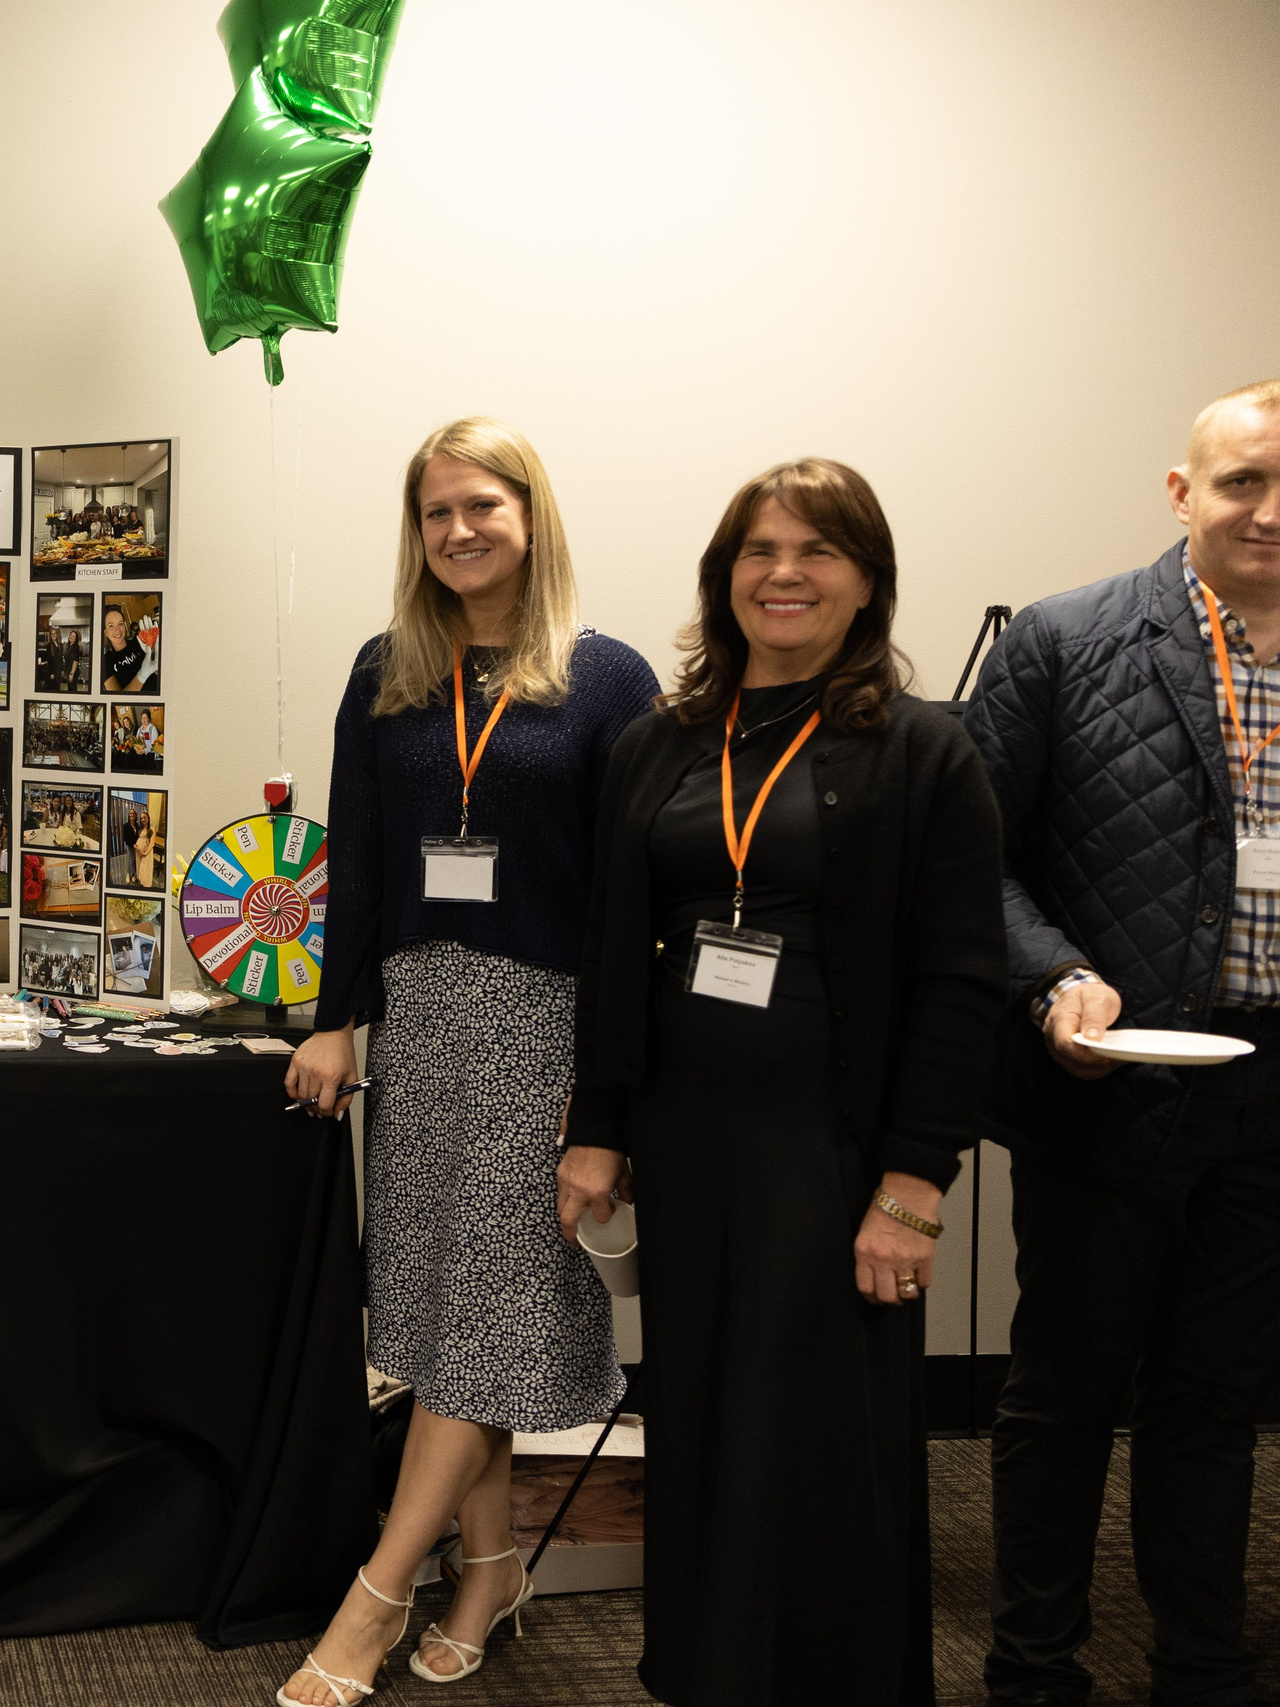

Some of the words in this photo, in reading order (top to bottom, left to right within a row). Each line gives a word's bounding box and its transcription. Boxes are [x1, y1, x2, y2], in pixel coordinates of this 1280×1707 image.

[102, 568, 119, 576] STAFF
[237, 825, 252, 849] Pen
[287, 819, 305, 860] Sticker
[201, 851, 236, 882] Sticker
[263, 877, 288, 886] WHIRL
[185, 904, 203, 917] Lip
[206, 903, 235, 914] Balm
[203, 924, 254, 970] Devotional
[263, 936, 287, 944] WHIRL
[246, 955, 264, 995] Sticker
[293, 963, 308, 986] Pen
